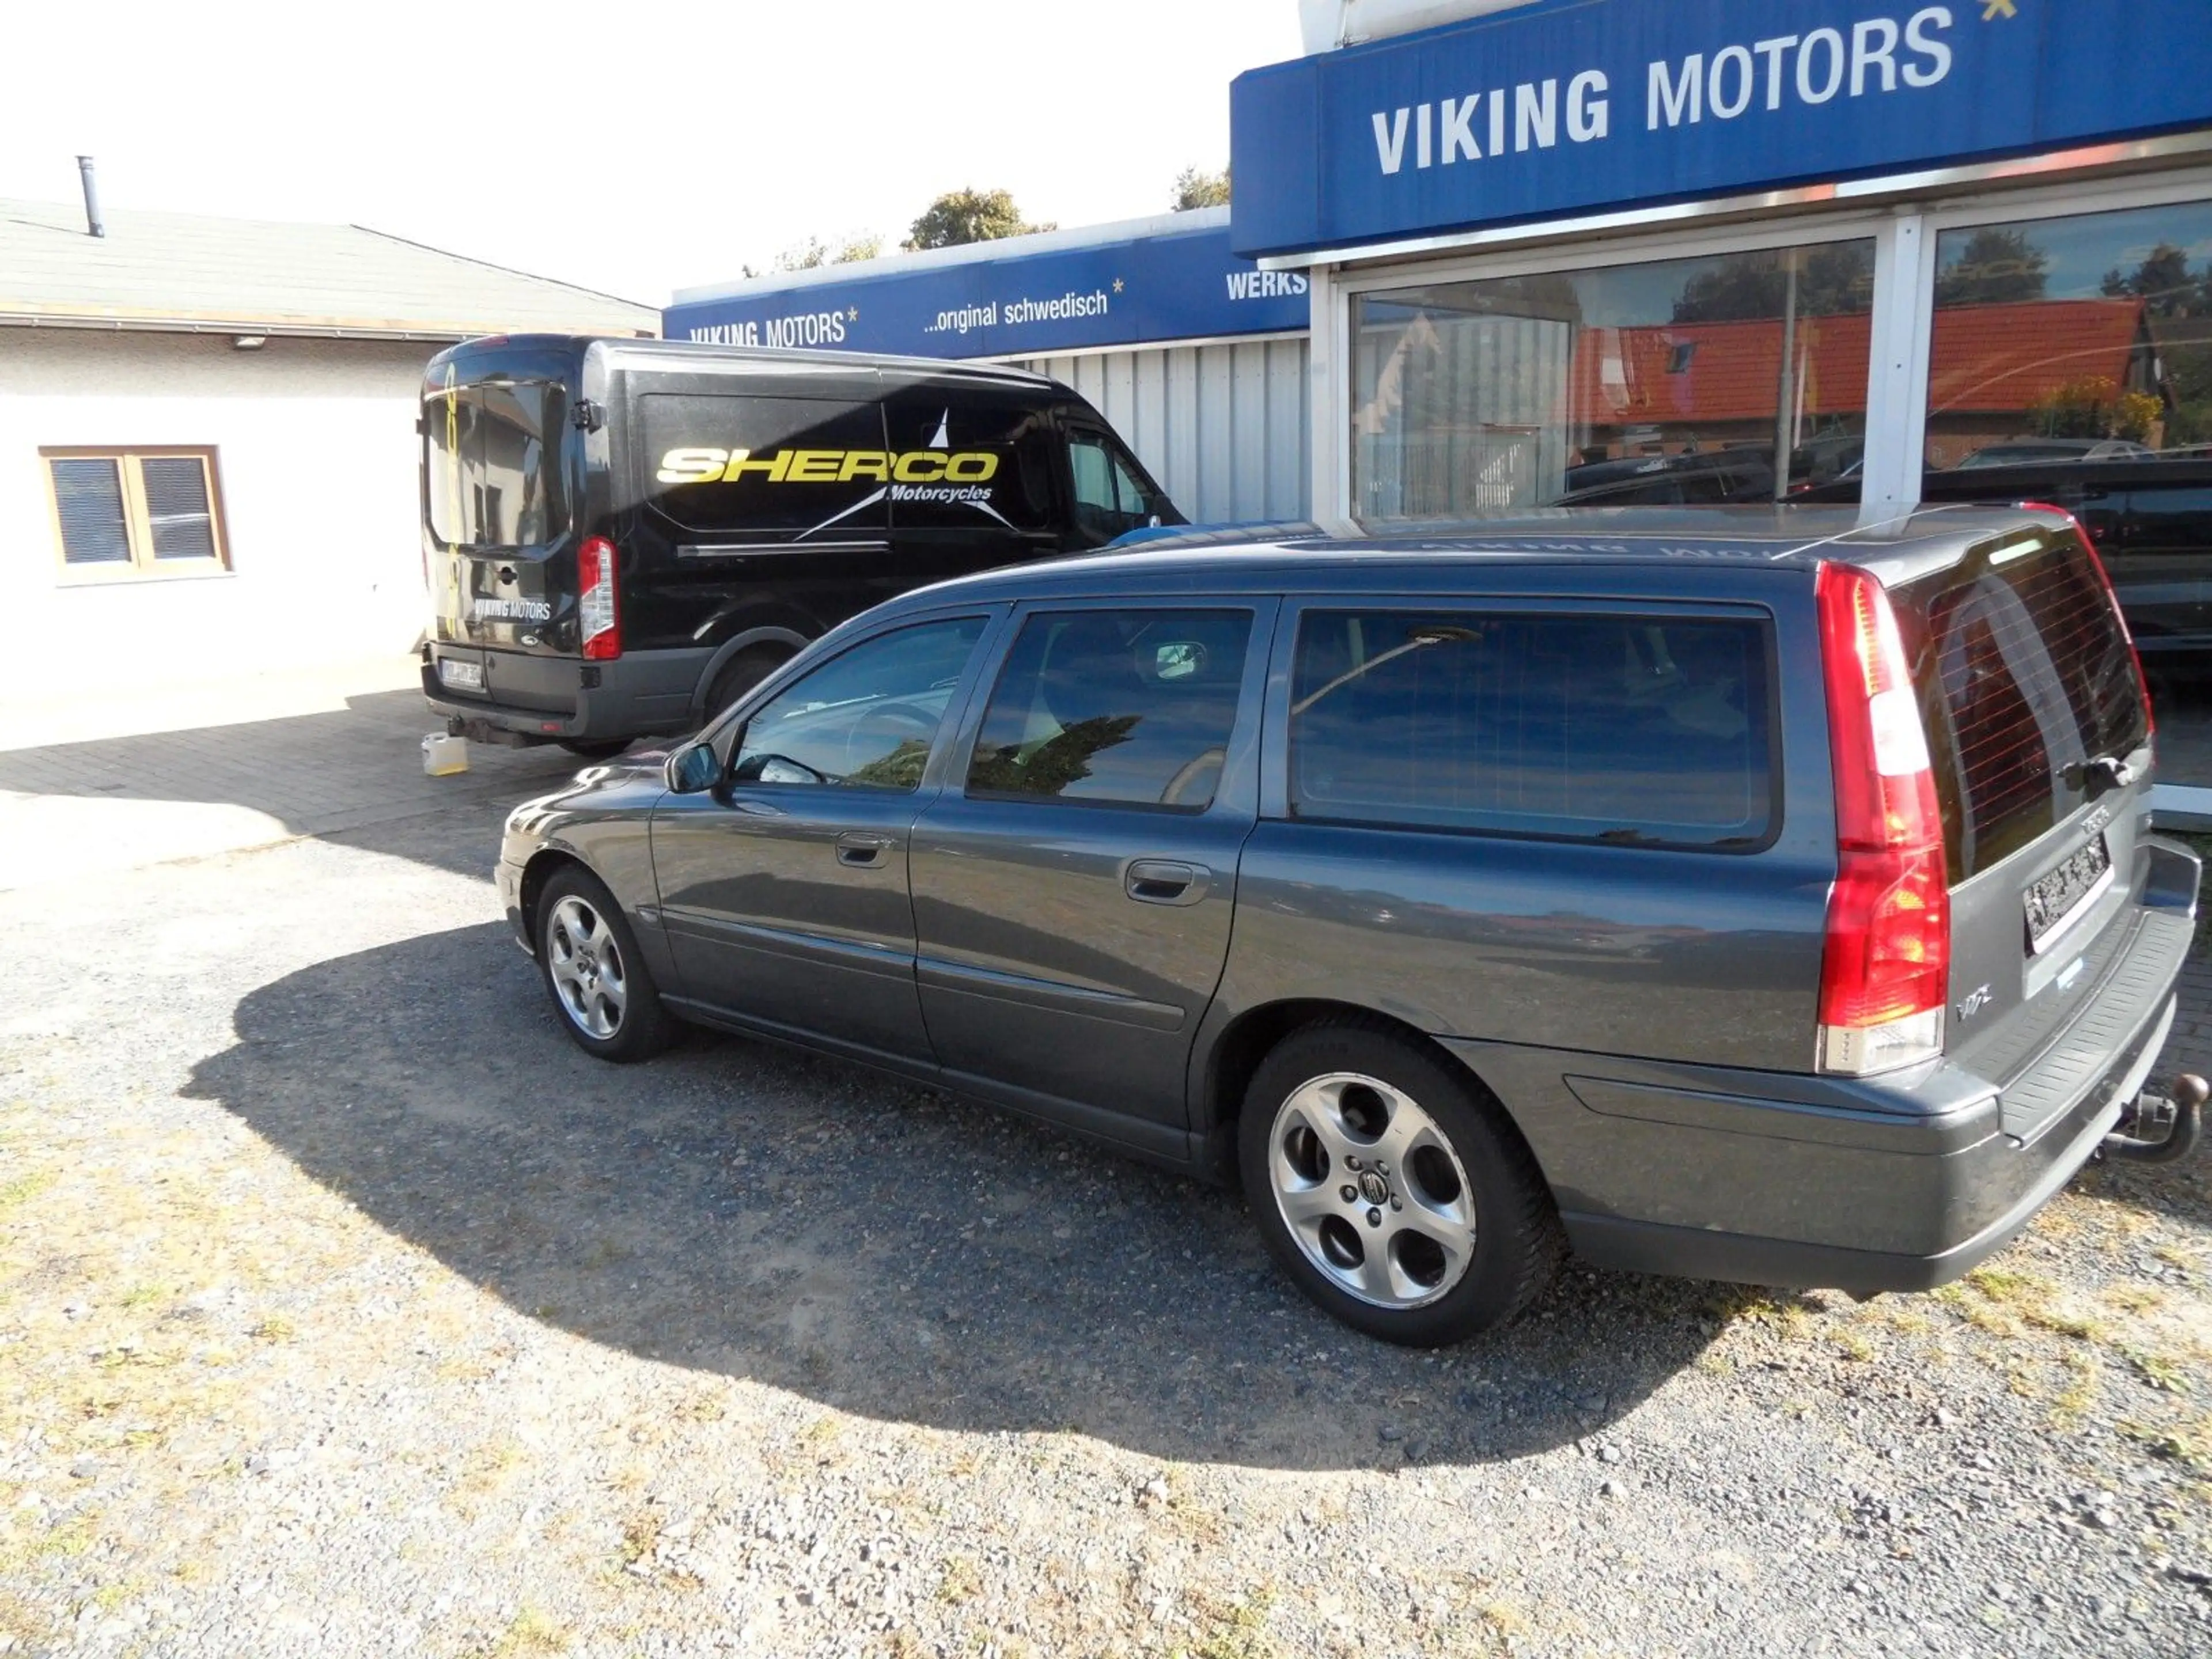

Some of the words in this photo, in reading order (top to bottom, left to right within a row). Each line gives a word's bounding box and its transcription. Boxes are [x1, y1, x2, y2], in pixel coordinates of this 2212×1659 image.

[1372, 70, 1608, 175] VIKING
[1647, 7, 1953, 130] MOTORS
[1226, 271, 1307, 300] WERKS
[1005, 289, 1108, 325] schwedisch
[690, 321, 759, 347] VIKING
[766, 311, 845, 348] MOTORS
[657, 448, 999, 483] SHERCO
[891, 484, 992, 503] Motorcycles
[475, 599, 509, 618] VIKING
[509, 601, 551, 620] MOTORS
